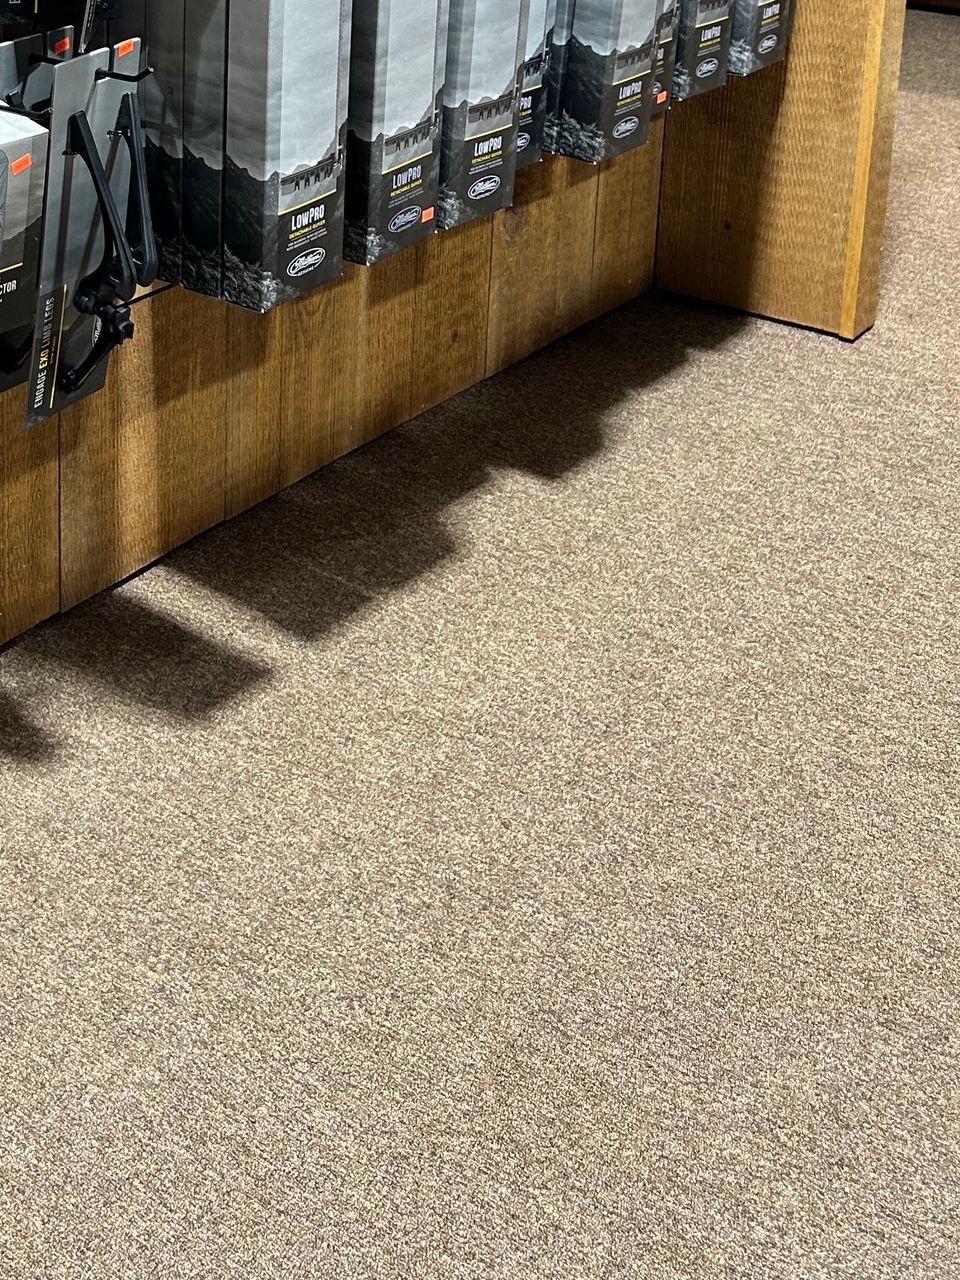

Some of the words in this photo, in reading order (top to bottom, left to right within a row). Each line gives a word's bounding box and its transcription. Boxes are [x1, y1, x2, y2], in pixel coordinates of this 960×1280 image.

[45, 296, 55, 321] LEGS
[41, 321, 53, 347] LIMB
[38, 348, 51, 370] EXO
[33, 369, 47, 409] ENGAGE
